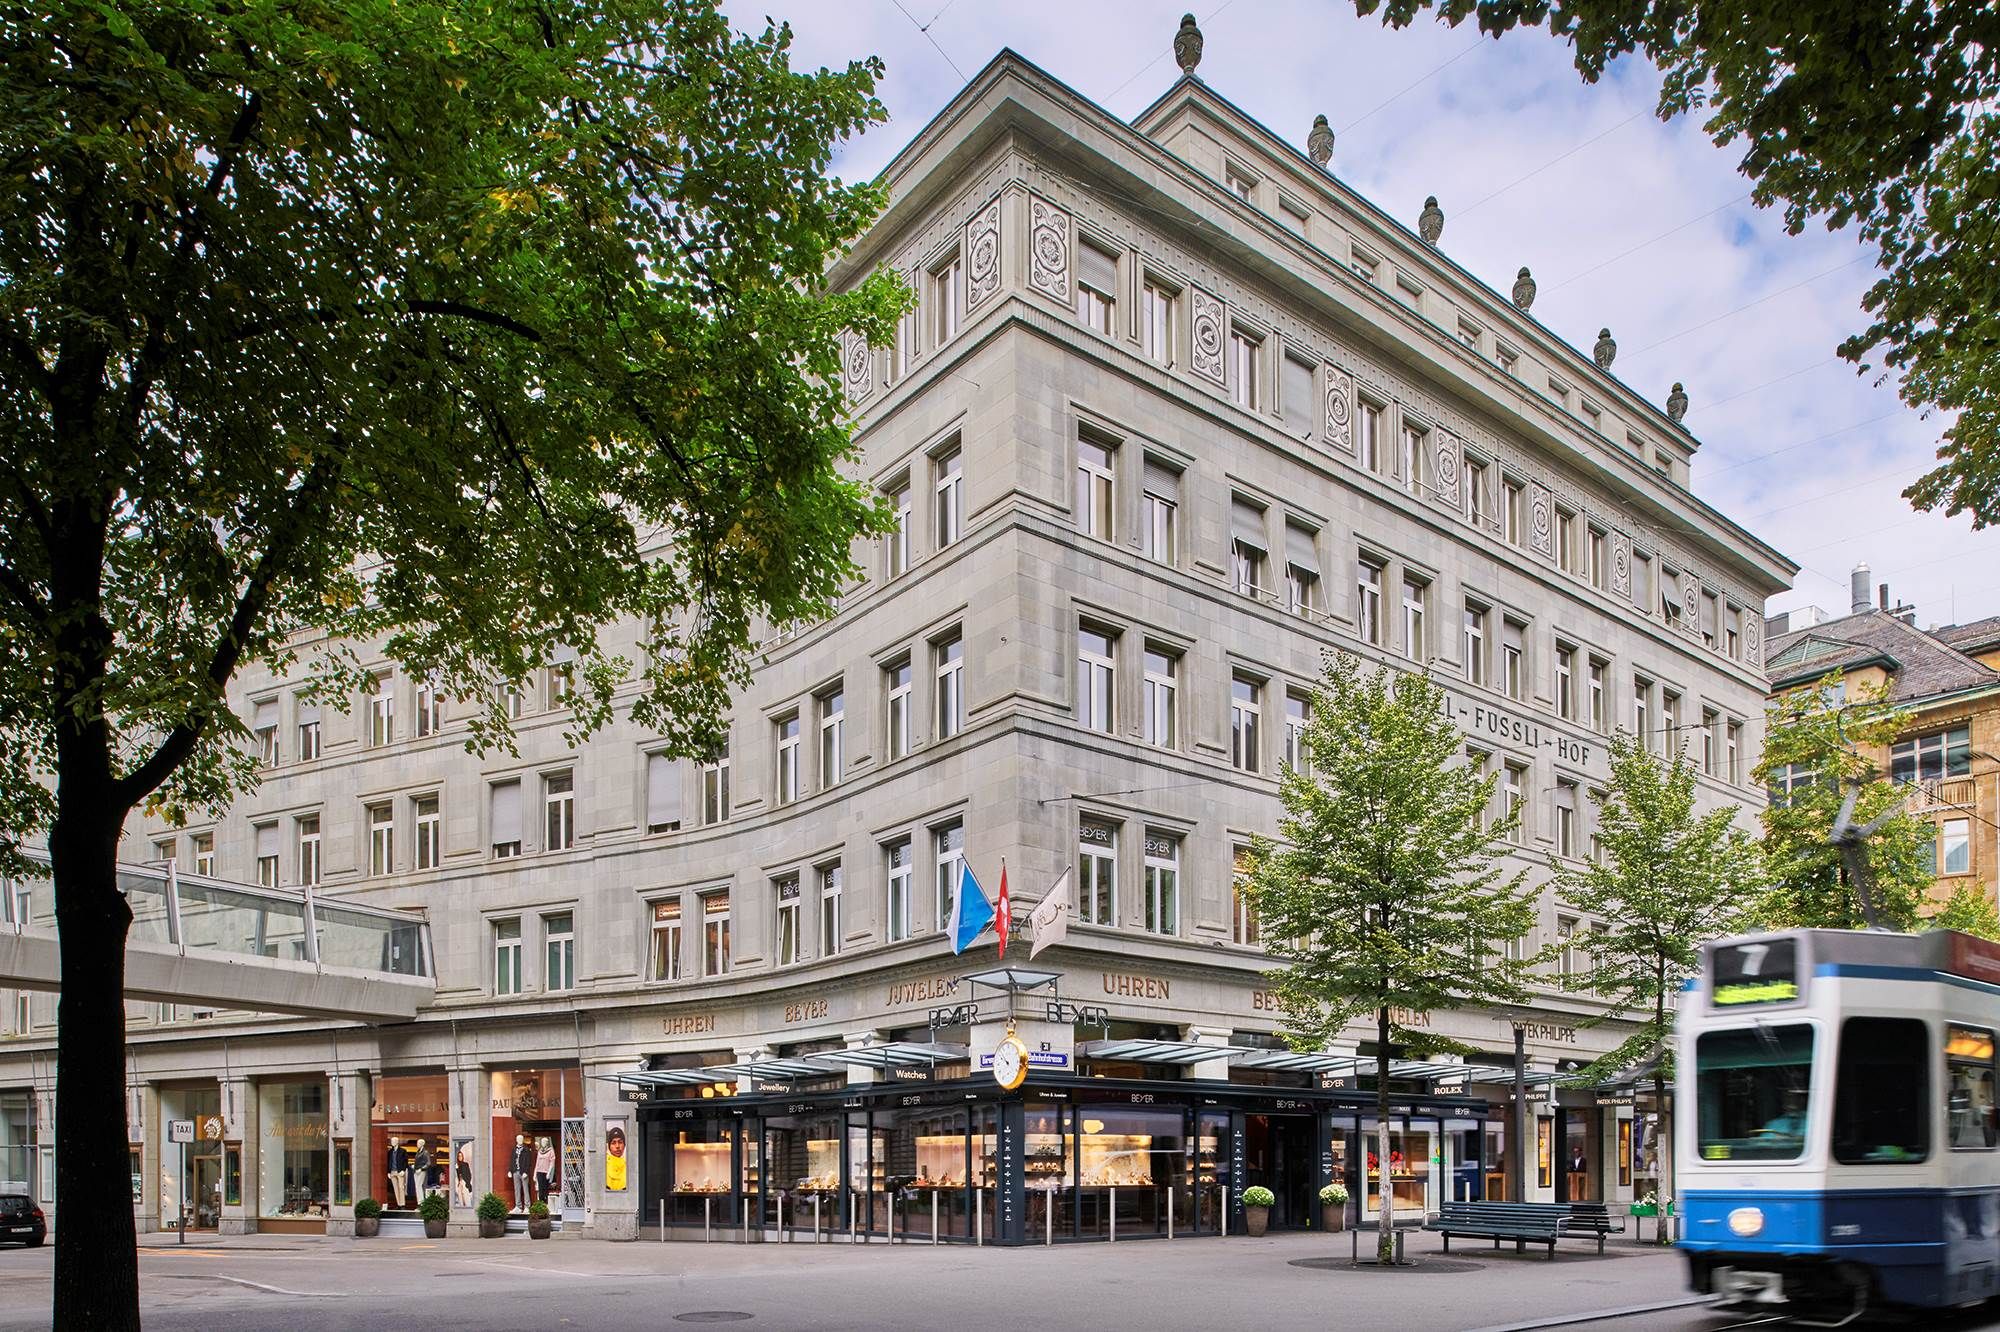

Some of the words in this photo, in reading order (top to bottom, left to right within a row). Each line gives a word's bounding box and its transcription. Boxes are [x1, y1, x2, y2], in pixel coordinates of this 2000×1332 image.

[1079, 825, 1108, 841] BEYER
[1736, 944, 1770, 976] 7
[886, 975, 958, 1006] JUWELEN
[1102, 973, 1170, 1000] UHREN
[784, 999, 828, 1023] BEYER
[928, 1002, 982, 1030] BEYER
[1046, 1001, 1110, 1029] BEYER
[663, 1015, 715, 1035] UHREN
[1541, 1024, 1576, 1043] PHILIPPE
[896, 1069, 927, 1080] Watches
[758, 1083, 790, 1094] Jewellery
[1322, 1079, 1344, 1089] BEYER
[1434, 1086, 1463, 1095] ROLEX
[629, 1092, 648, 1100] BEYER
[903, 1096, 921, 1105] BEYER
[1131, 1093, 1154, 1103] BEYER
[378, 1103, 436, 1113] FRATELLI
[789, 1104, 804, 1113] BEYER
[1276, 1100, 1296, 1109] BEYER
[675, 1110, 693, 1118] BEYER
[1454, 1107, 1471, 1116] BEYER
[176, 1124, 192, 1133] TAXI
